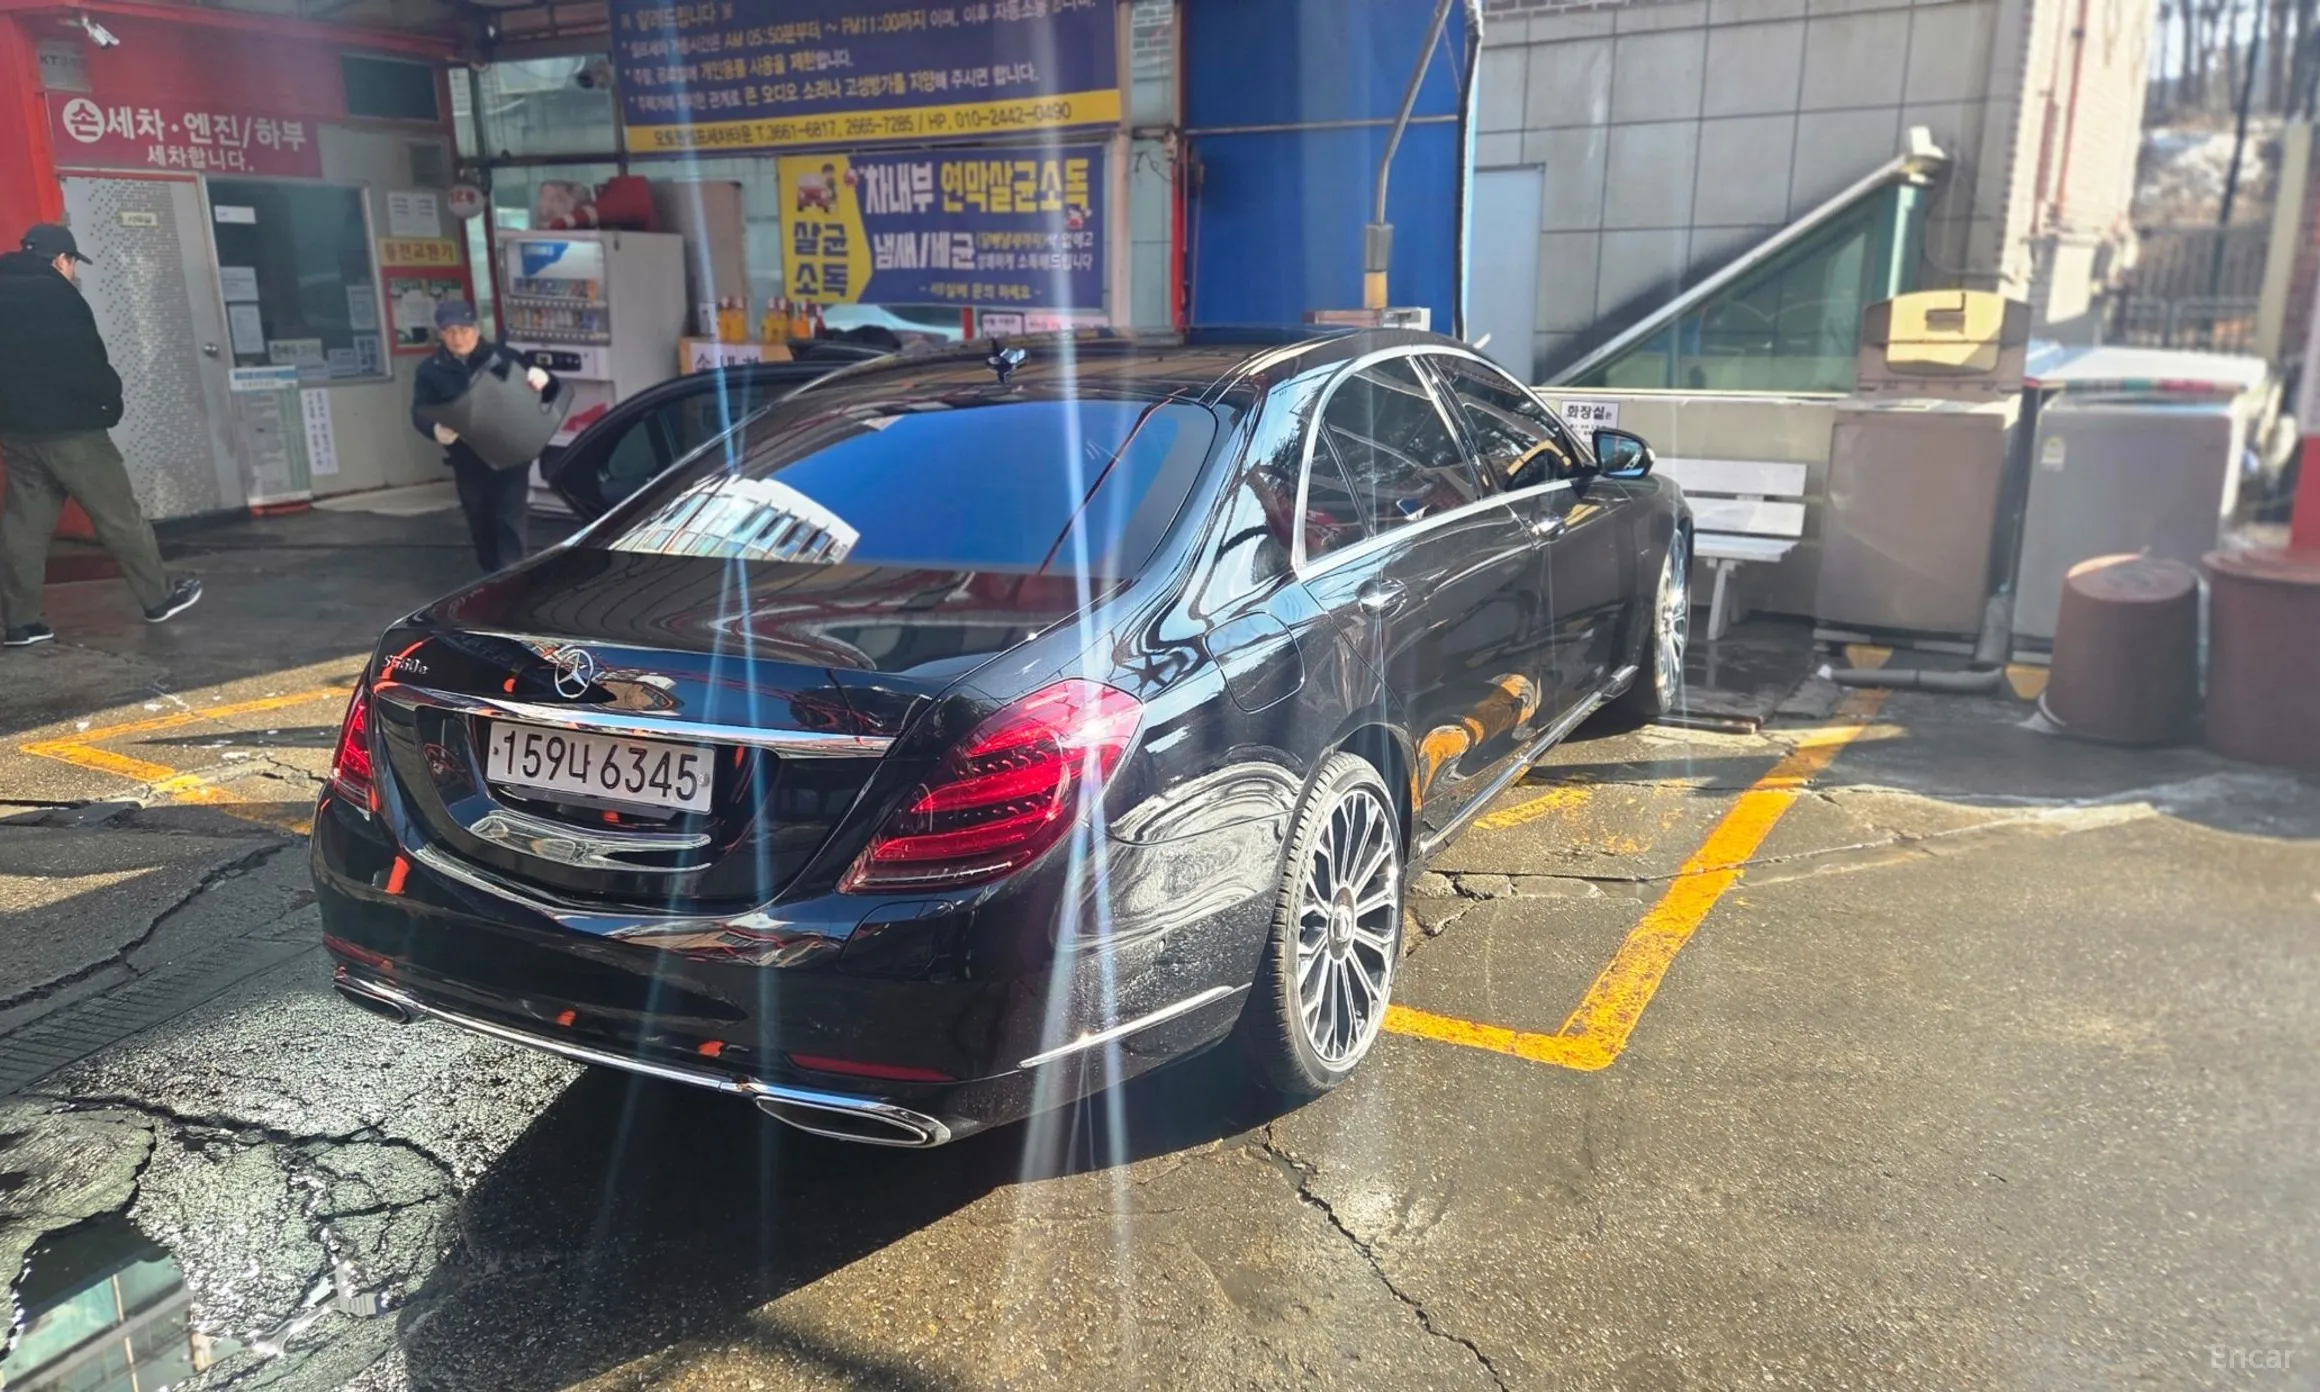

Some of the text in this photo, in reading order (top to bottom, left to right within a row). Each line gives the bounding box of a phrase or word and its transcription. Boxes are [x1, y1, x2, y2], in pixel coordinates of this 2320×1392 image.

[725, 32, 743, 47] AM
[762, 82, 798, 103] 오디오
[803, 78, 842, 100] 소리나
[951, 65, 989, 89] 주시면
[955, 101, 1071, 128] 010-2442-0490
[147, 145, 254, 172] 세차합니다.
[865, 157, 1089, 214] 차내부 연막살균소독
[384, 240, 454, 262] 동전교환기
[793, 221, 848, 257] 살균
[873, 231, 975, 271] 냄새/세균
[793, 262, 848, 297] 소독
[503, 730, 699, 802] 159나 6345
